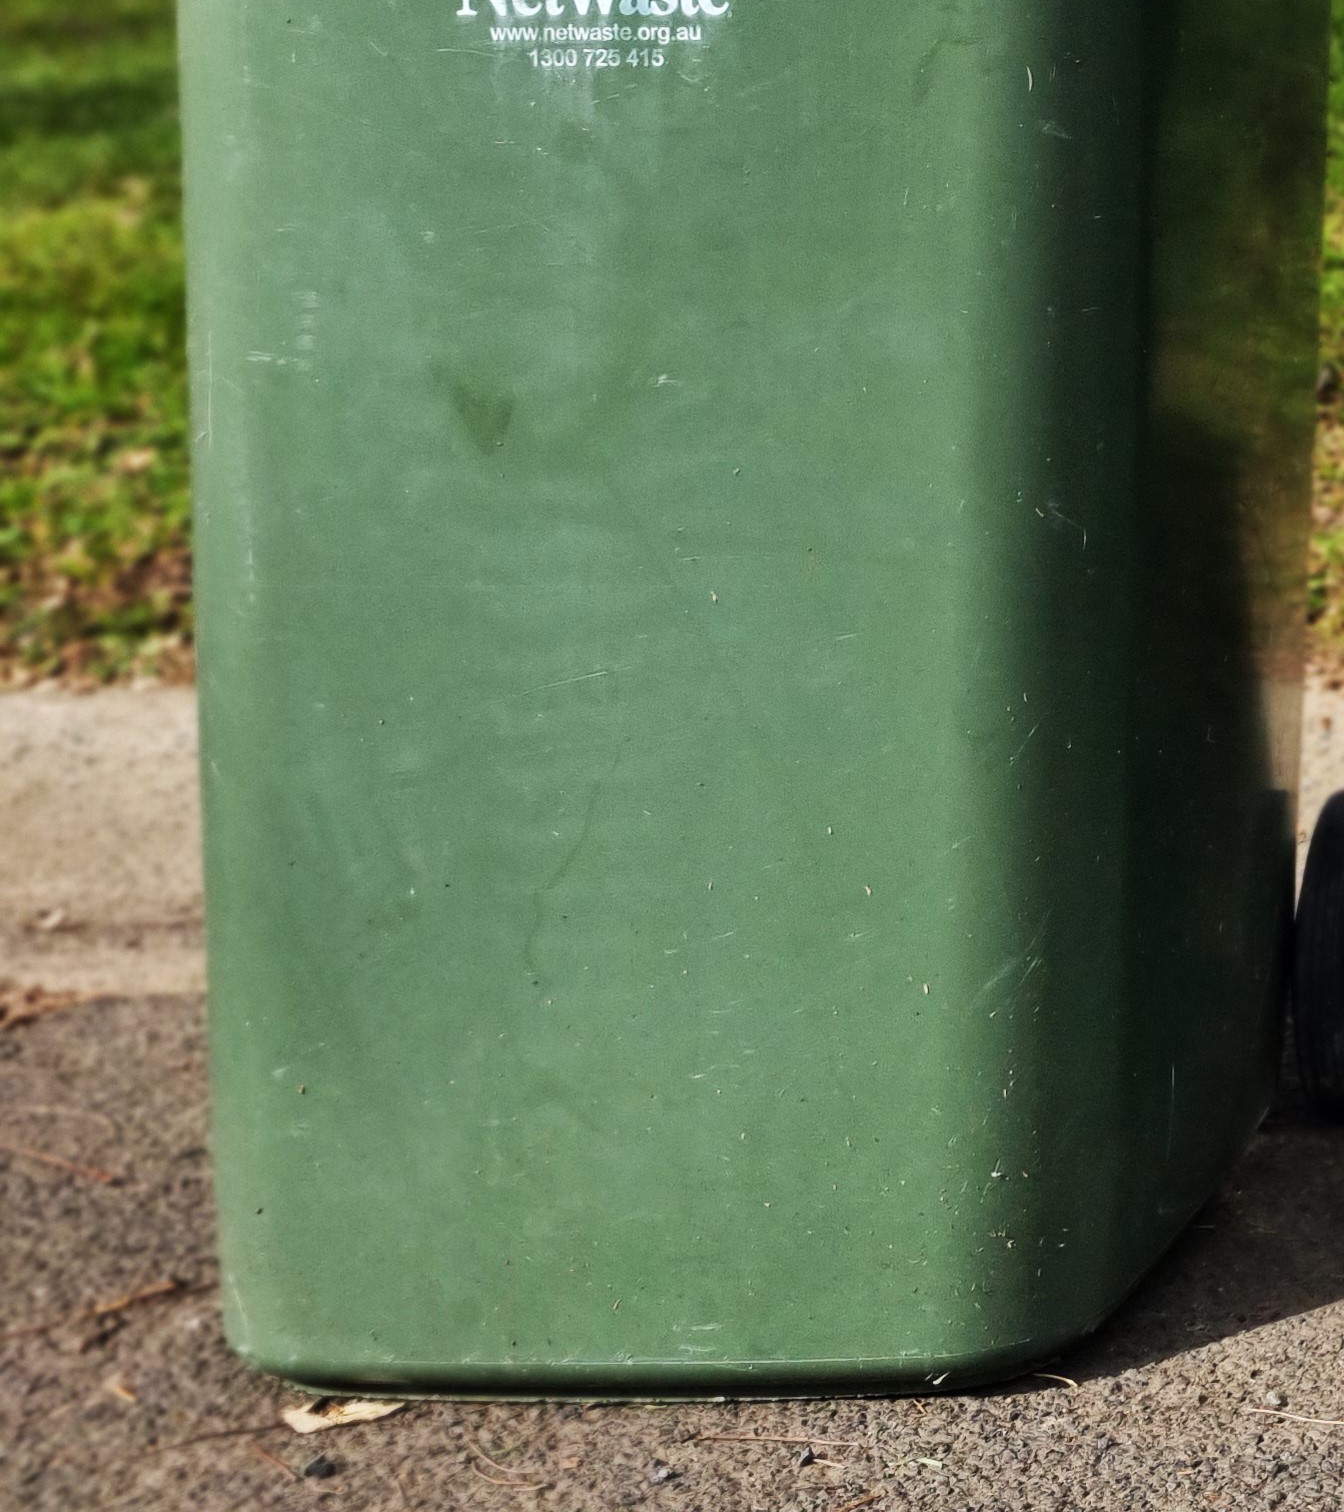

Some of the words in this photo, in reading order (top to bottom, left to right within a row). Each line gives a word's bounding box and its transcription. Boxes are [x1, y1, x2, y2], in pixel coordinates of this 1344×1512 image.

[490, 24, 701, 44] www.netwaste.org.au
[529, 49, 577, 66] 1300
[583, 49, 620, 66] 725
[626, 49, 664, 66] 415
